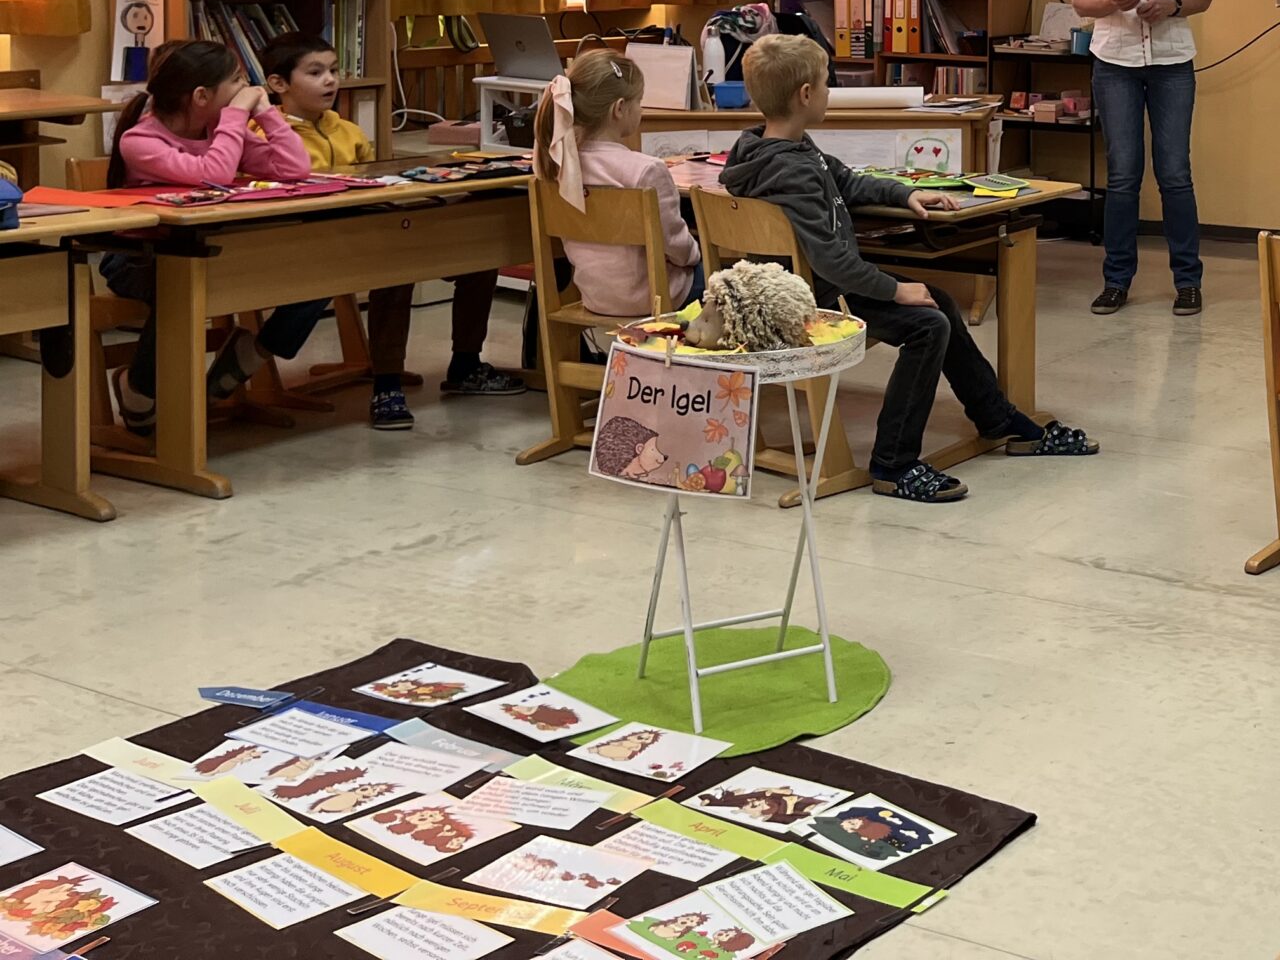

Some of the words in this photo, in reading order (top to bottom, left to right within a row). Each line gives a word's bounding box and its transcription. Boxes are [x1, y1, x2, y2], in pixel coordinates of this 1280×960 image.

[627, 376, 664, 405] Der
[671, 384, 711, 416] Igel
[689, 821, 728, 838] April
[327, 851, 372, 876] August
[825, 866, 859, 883] Mai
